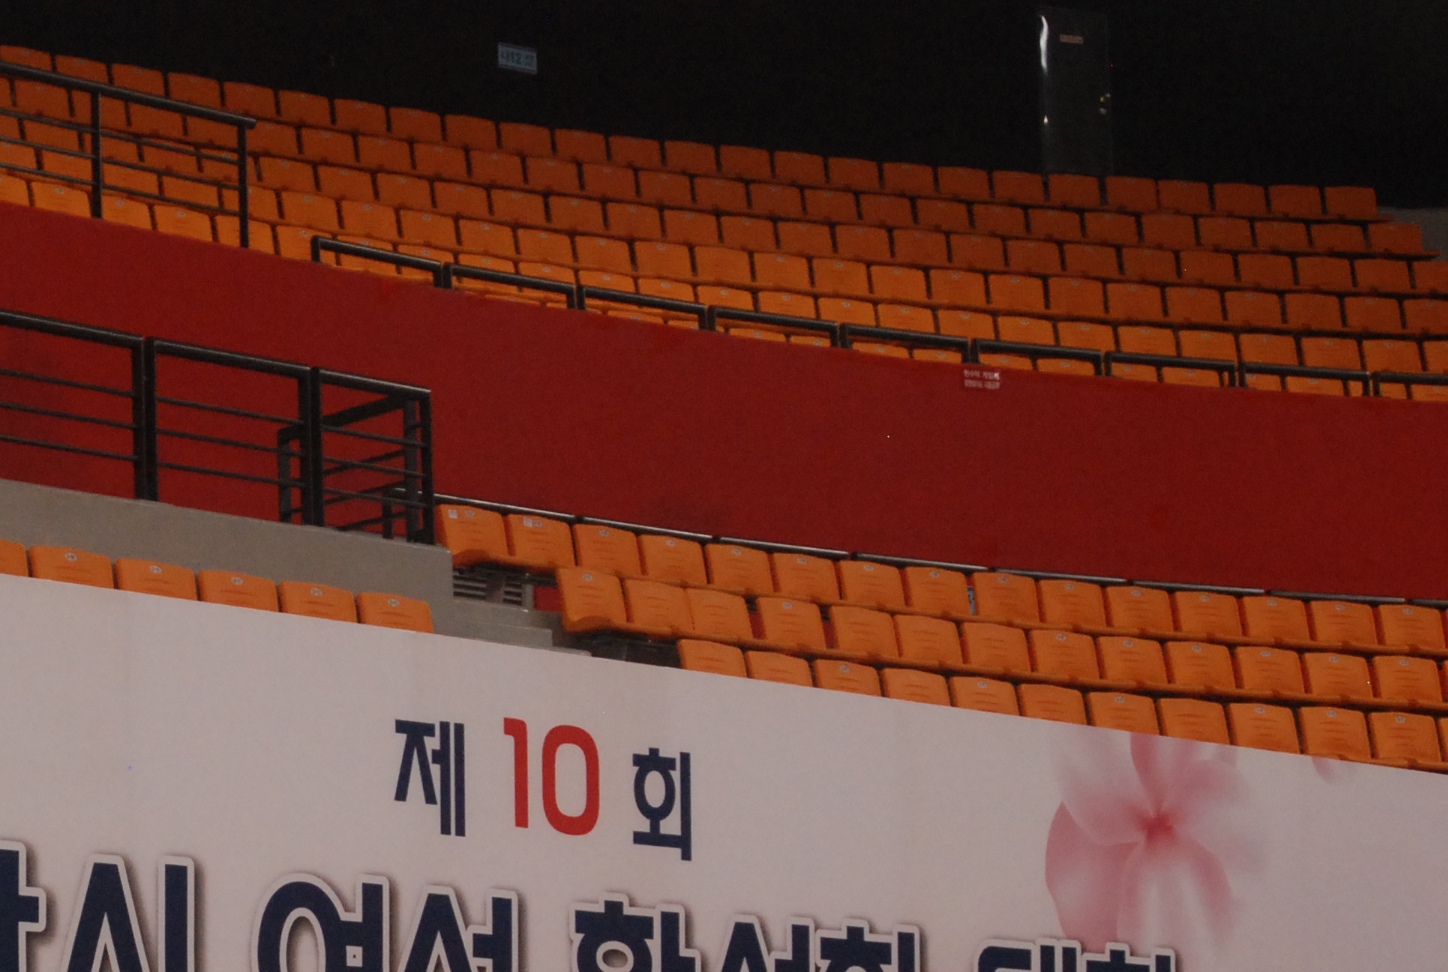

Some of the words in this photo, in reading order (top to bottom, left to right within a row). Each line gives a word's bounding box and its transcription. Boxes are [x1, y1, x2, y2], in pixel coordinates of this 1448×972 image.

[395, 720, 466, 837] 제
[503, 717, 600, 836] 10
[632, 747, 692, 861] 회
